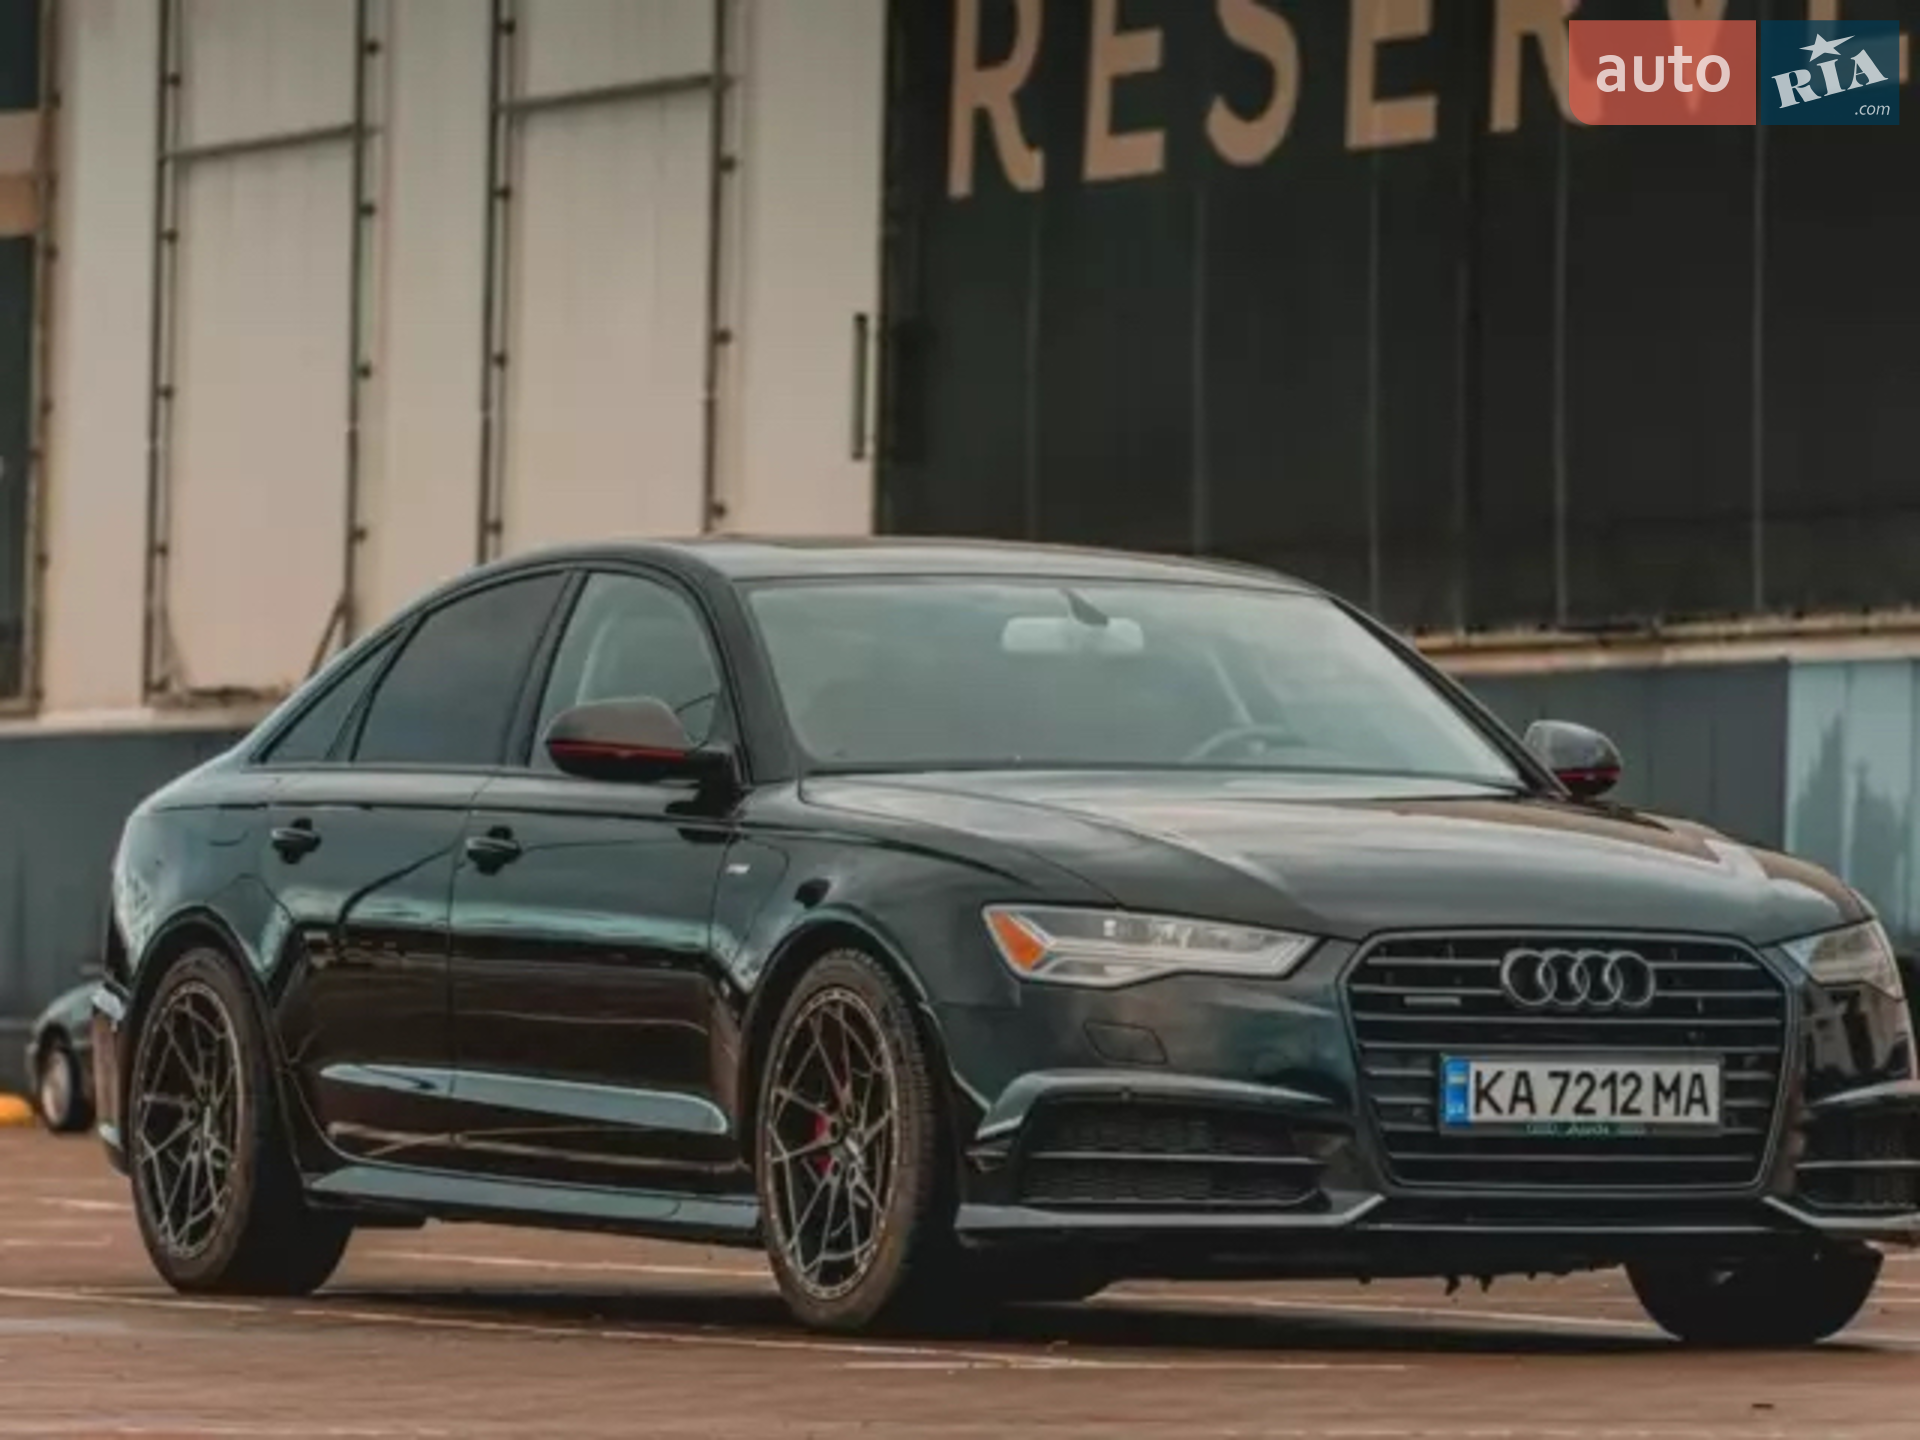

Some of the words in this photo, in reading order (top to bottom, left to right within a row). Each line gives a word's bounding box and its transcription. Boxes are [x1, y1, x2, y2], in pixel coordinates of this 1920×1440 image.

[1474, 1070, 1537, 1115] KA
[1547, 1070, 1643, 1116] 7212
[1652, 1071, 1710, 1117] MA
